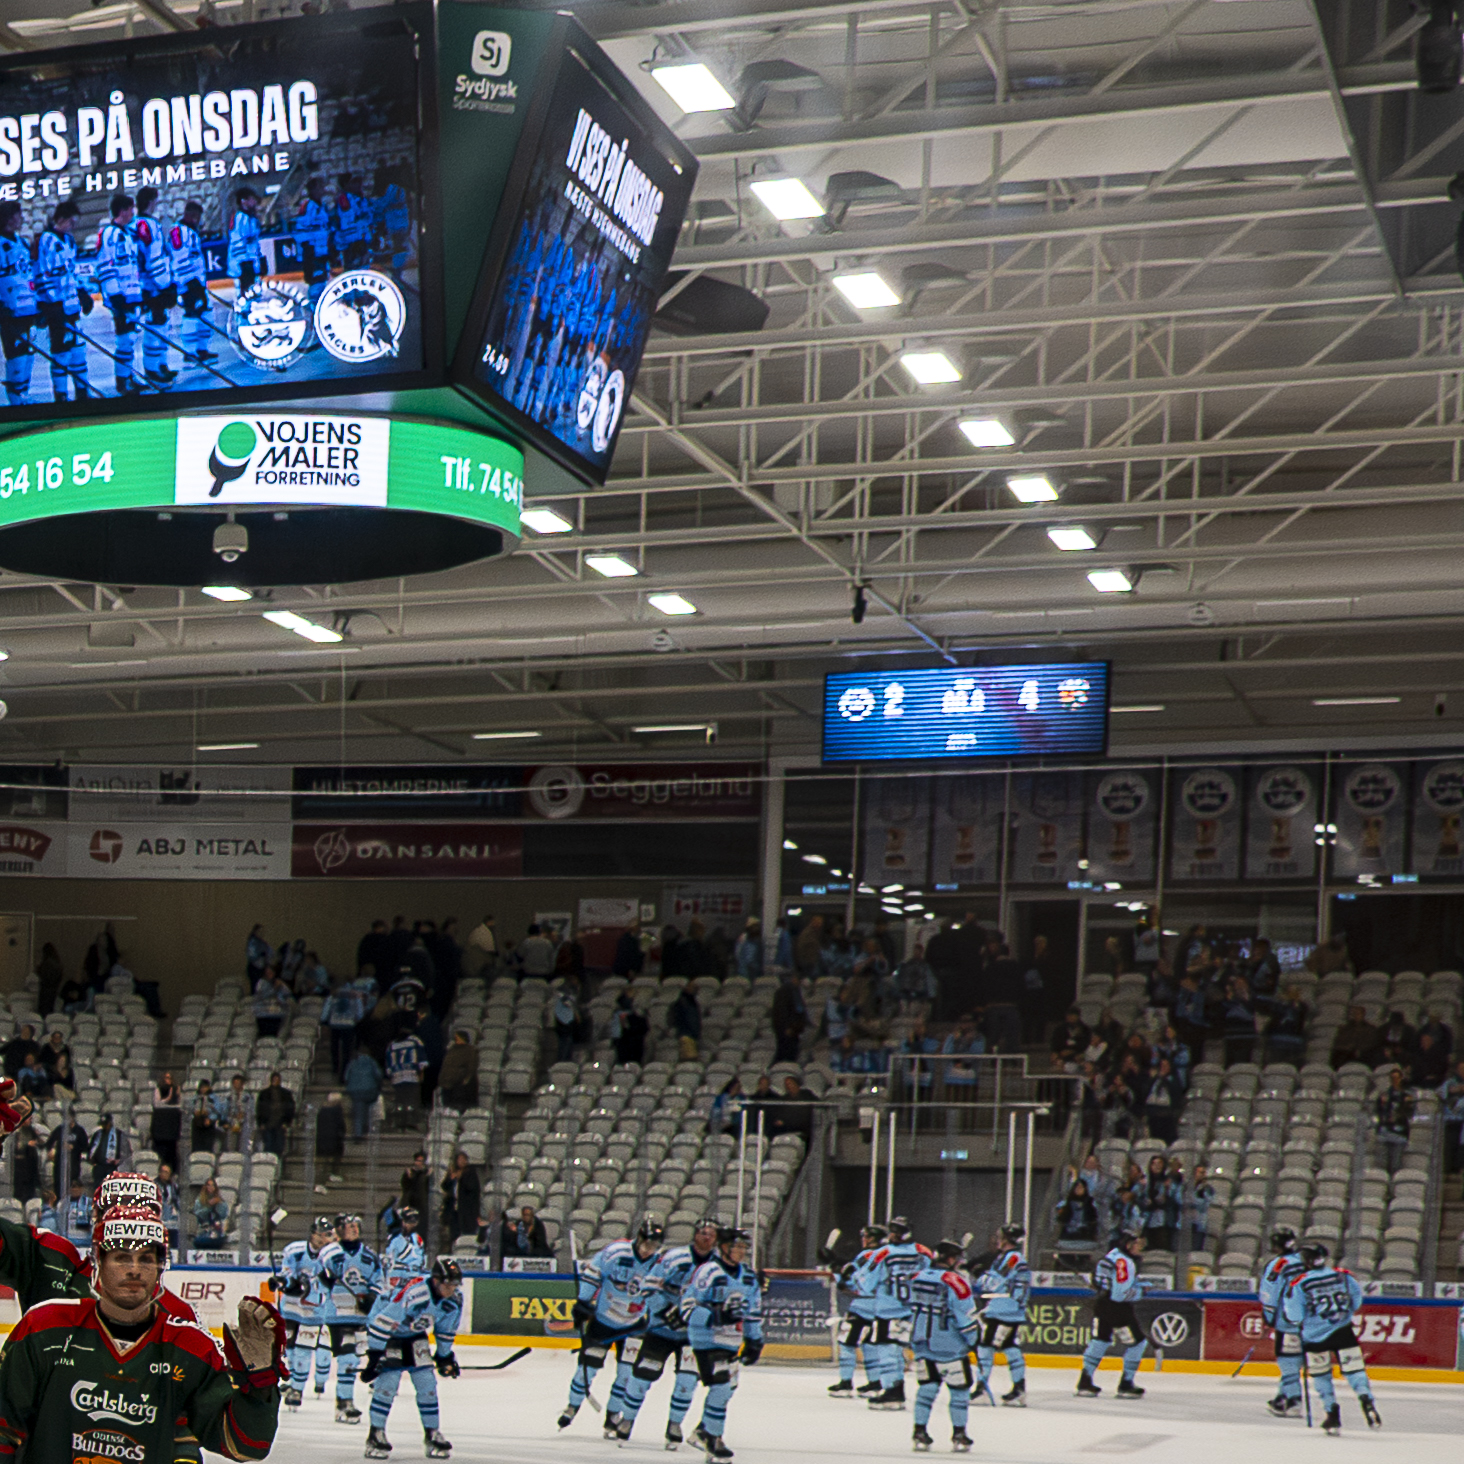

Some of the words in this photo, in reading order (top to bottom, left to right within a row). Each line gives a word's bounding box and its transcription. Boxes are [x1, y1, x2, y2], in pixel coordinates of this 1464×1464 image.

[455, 74, 519, 100] Sydjysk
[77, 90, 136, 167] PÅ
[142, 80, 320, 159] ONSDAG
[86, 152, 291, 192] HJEMMEBANE
[256, 421, 362, 445] VOJENS
[257, 446, 359, 470] MALER
[0, 464, 30, 498] 54
[36, 457, 64, 491] 16
[72, 451, 114, 486] 54
[255, 471, 361, 487] FORRETNING
[441, 456, 475, 492] Tlf.
[479, 464, 501, 498] 74
[136, 837, 186, 858] ABJ
[195, 836, 275, 858] METAL
[355, 841, 494, 861] DANSANI
[103, 1181, 156, 1196] NEWTEC
[105, 1223, 163, 1239] NEWTEC
[70, 1379, 158, 1424] Carlsberg
[72, 1433, 145, 1461] BULLDOGS
[92, 1431, 125, 1444] ODENSE
